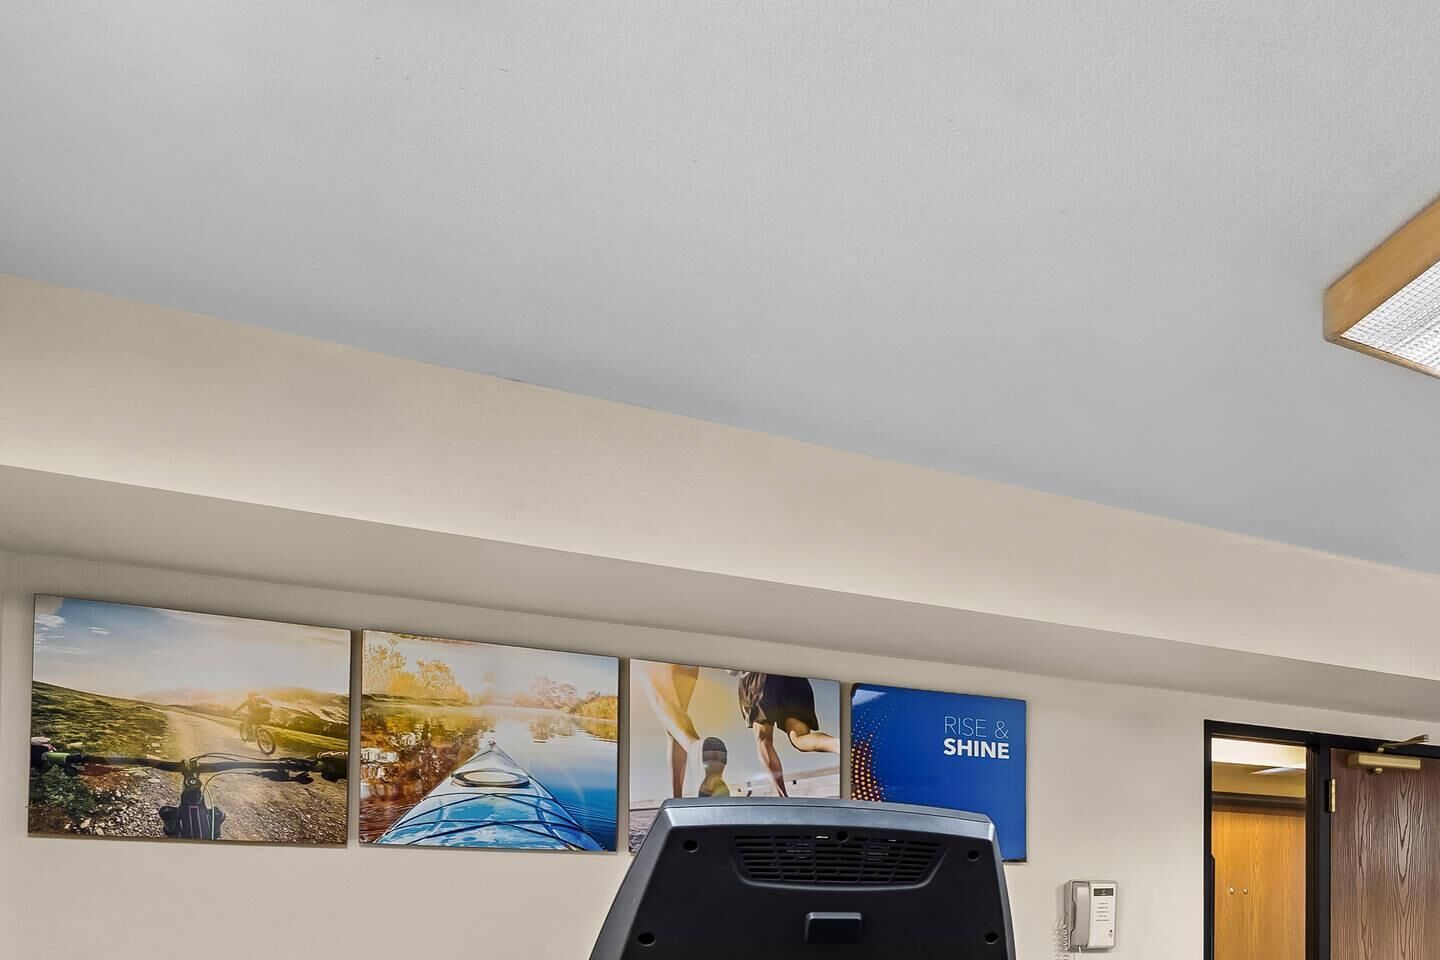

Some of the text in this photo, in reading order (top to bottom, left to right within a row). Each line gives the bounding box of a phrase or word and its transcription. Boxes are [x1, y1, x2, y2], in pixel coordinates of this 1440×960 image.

[944, 715, 1009, 739] RISE &
[943, 737, 1010, 760] SHINE
